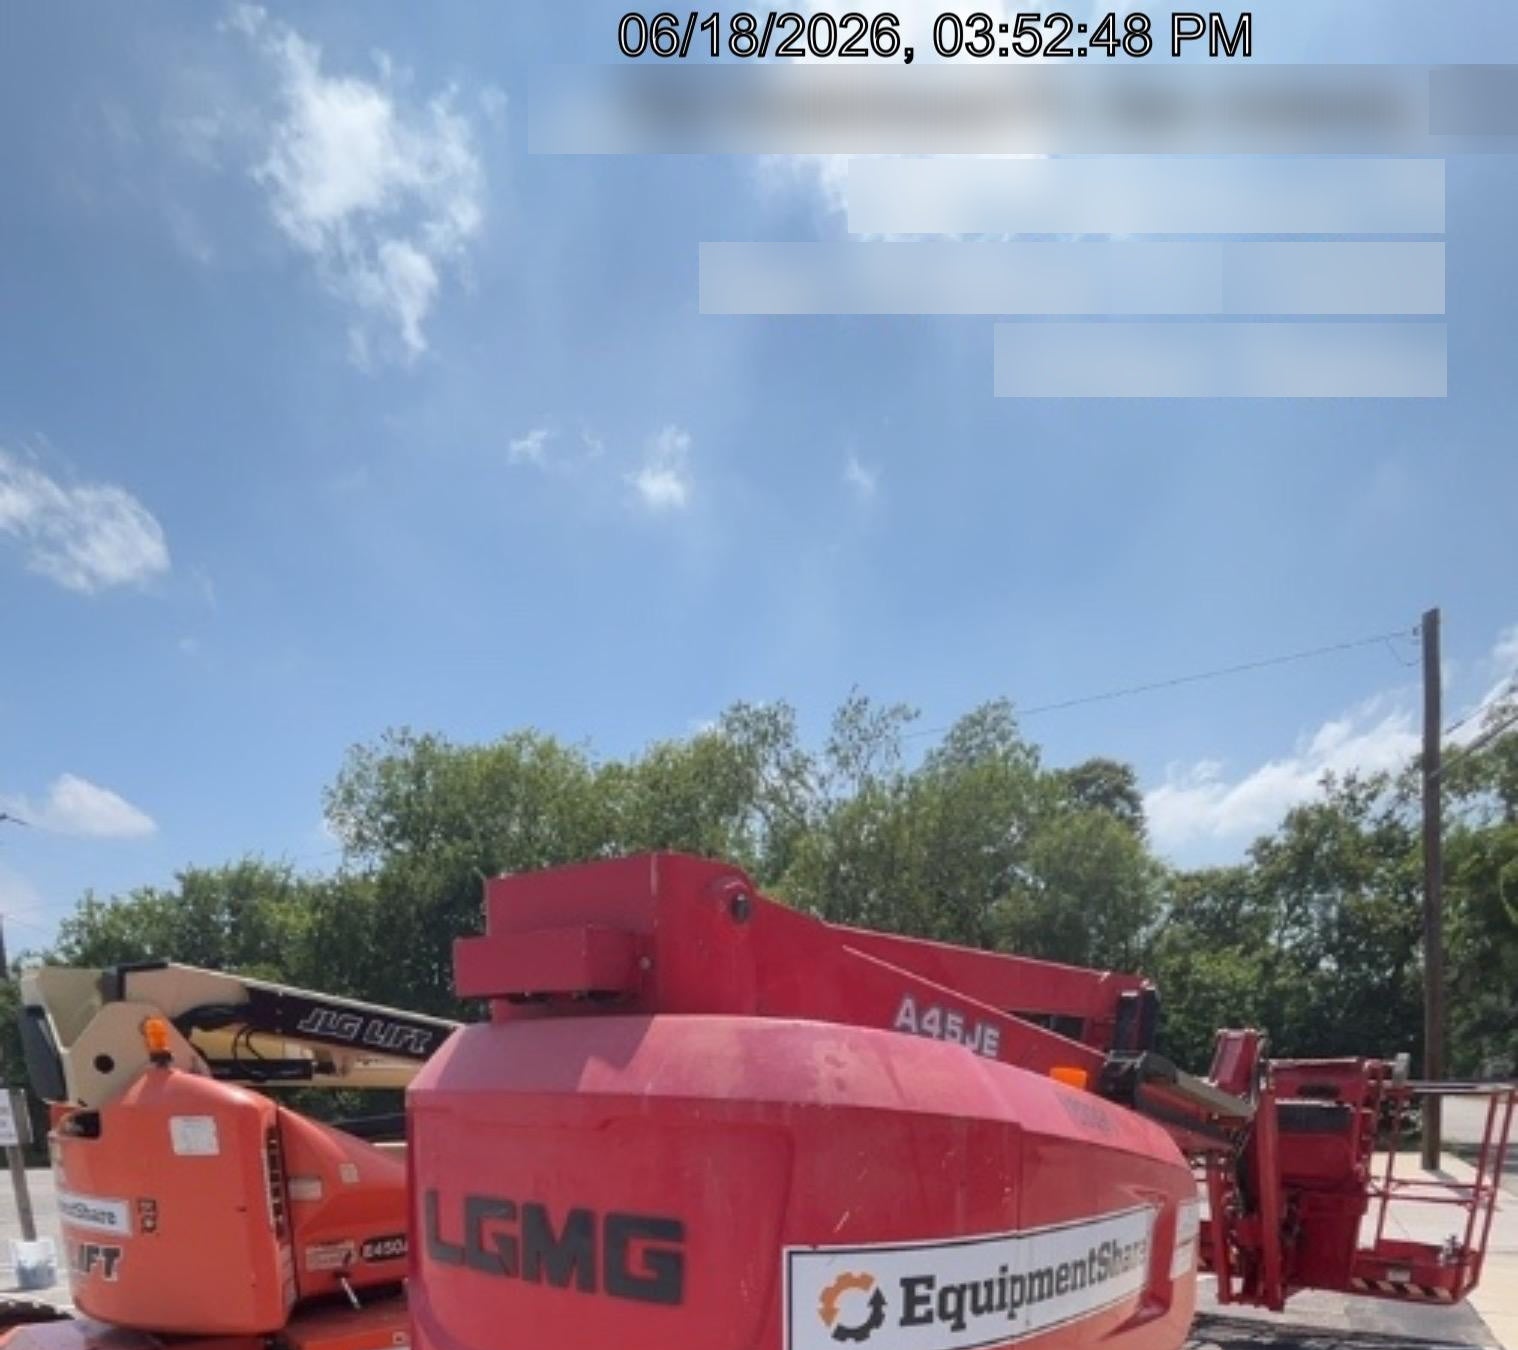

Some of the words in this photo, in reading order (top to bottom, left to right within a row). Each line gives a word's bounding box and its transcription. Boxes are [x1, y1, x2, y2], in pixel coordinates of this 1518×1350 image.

[297, 1007, 364, 1041] JLG
[363, 1019, 433, 1053] LIFT
[894, 998, 1000, 1057] A45JE
[77, 1243, 122, 1280] IFT
[424, 1189, 686, 1307] LGMG
[899, 1238, 1147, 1331] EquipmentShare
